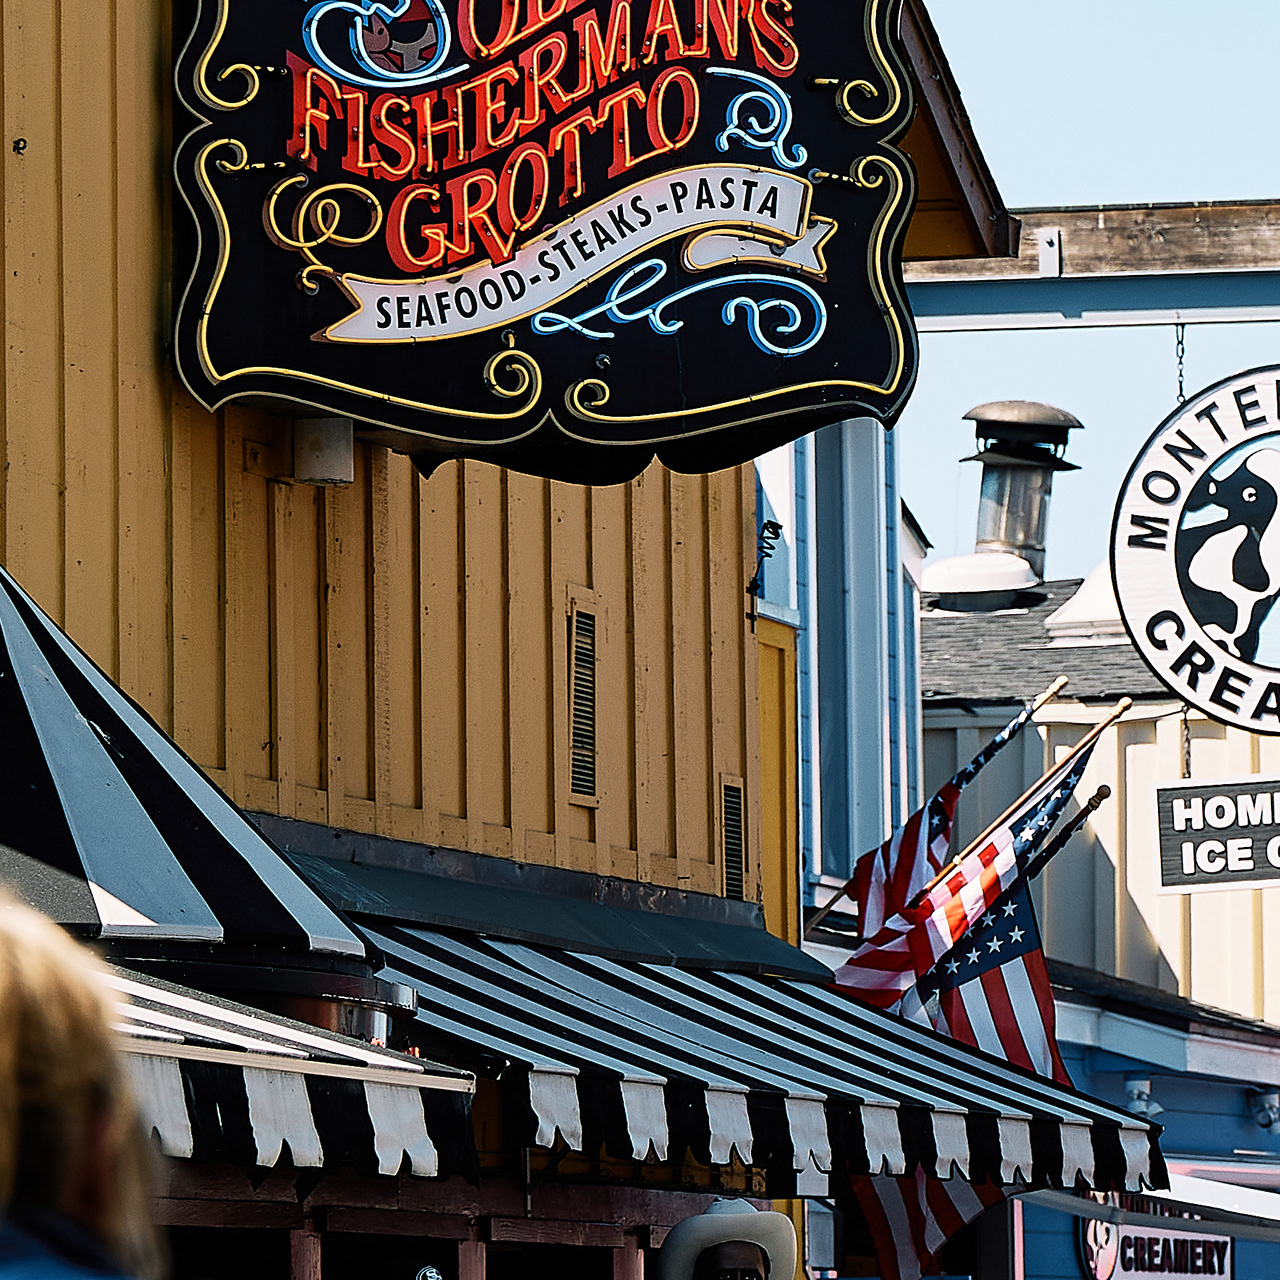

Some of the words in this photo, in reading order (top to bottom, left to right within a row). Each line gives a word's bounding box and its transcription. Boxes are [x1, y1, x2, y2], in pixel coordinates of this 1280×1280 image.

[384, 65, 701, 274] GROTTO
[1181, 841, 1255, 876] ICE
[1120, 1235, 1228, 1275] CREAMERY
